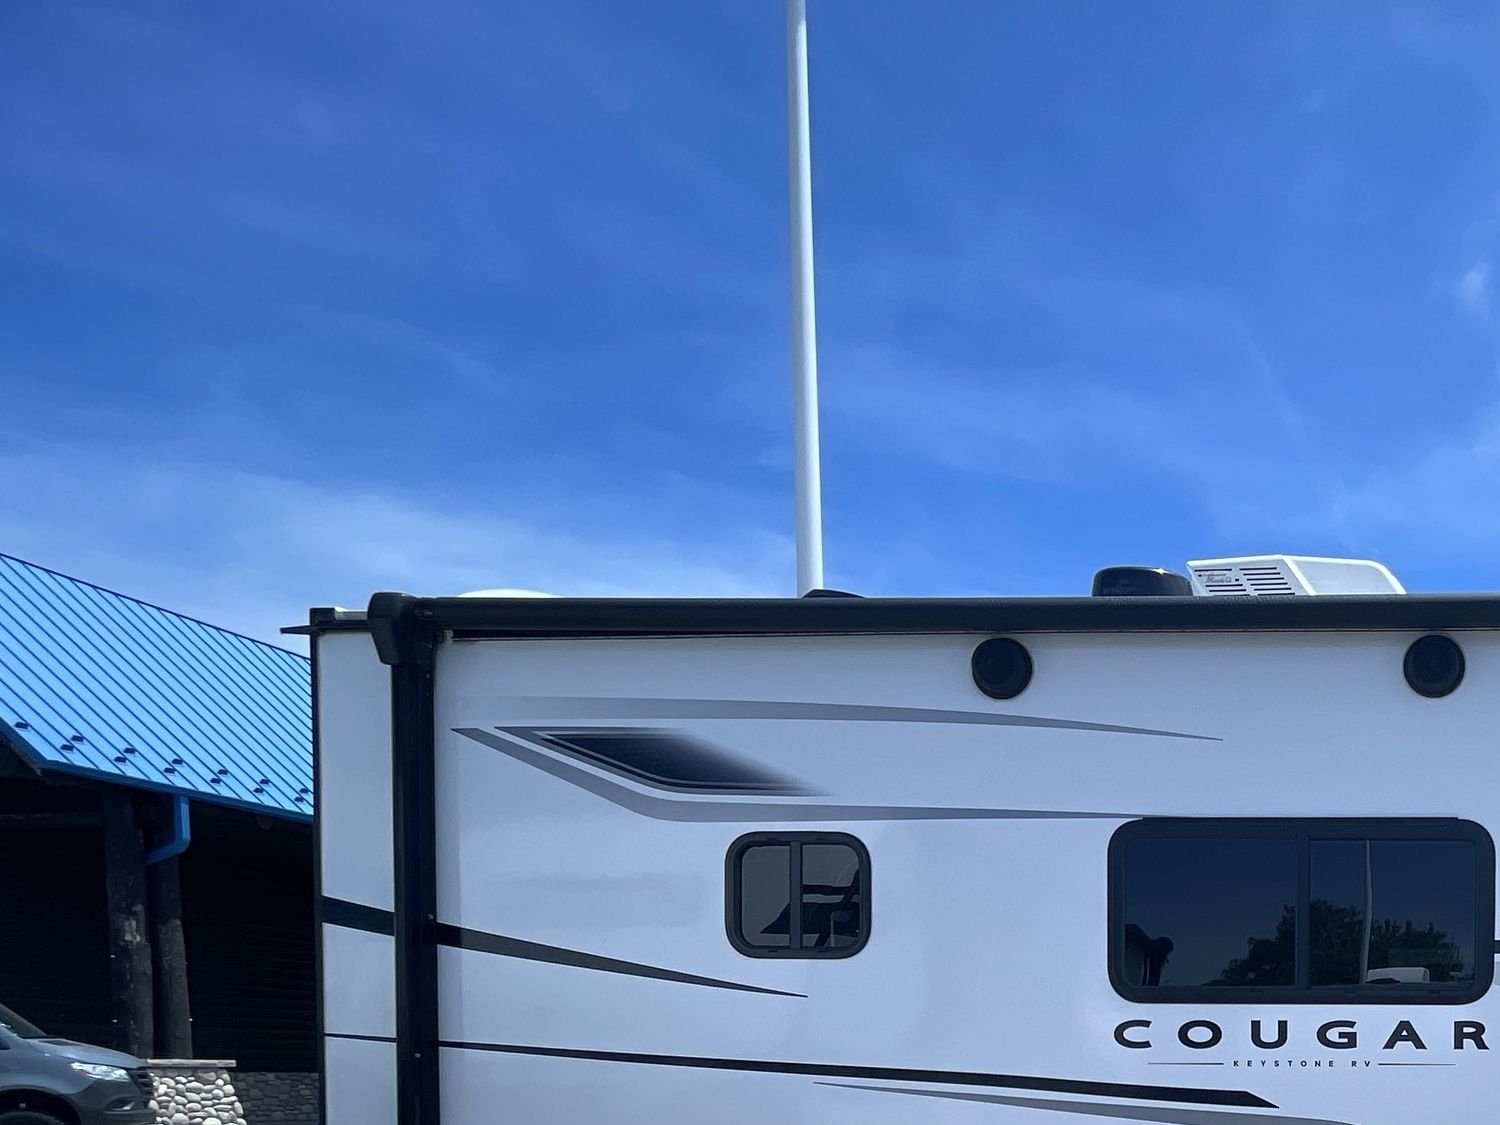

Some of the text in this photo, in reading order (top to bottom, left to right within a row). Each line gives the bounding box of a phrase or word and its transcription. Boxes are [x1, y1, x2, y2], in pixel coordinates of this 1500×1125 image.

[1113, 1019, 1490, 1051] COUGAR
[1233, 1059, 1373, 1068] KEYSTONE RV
